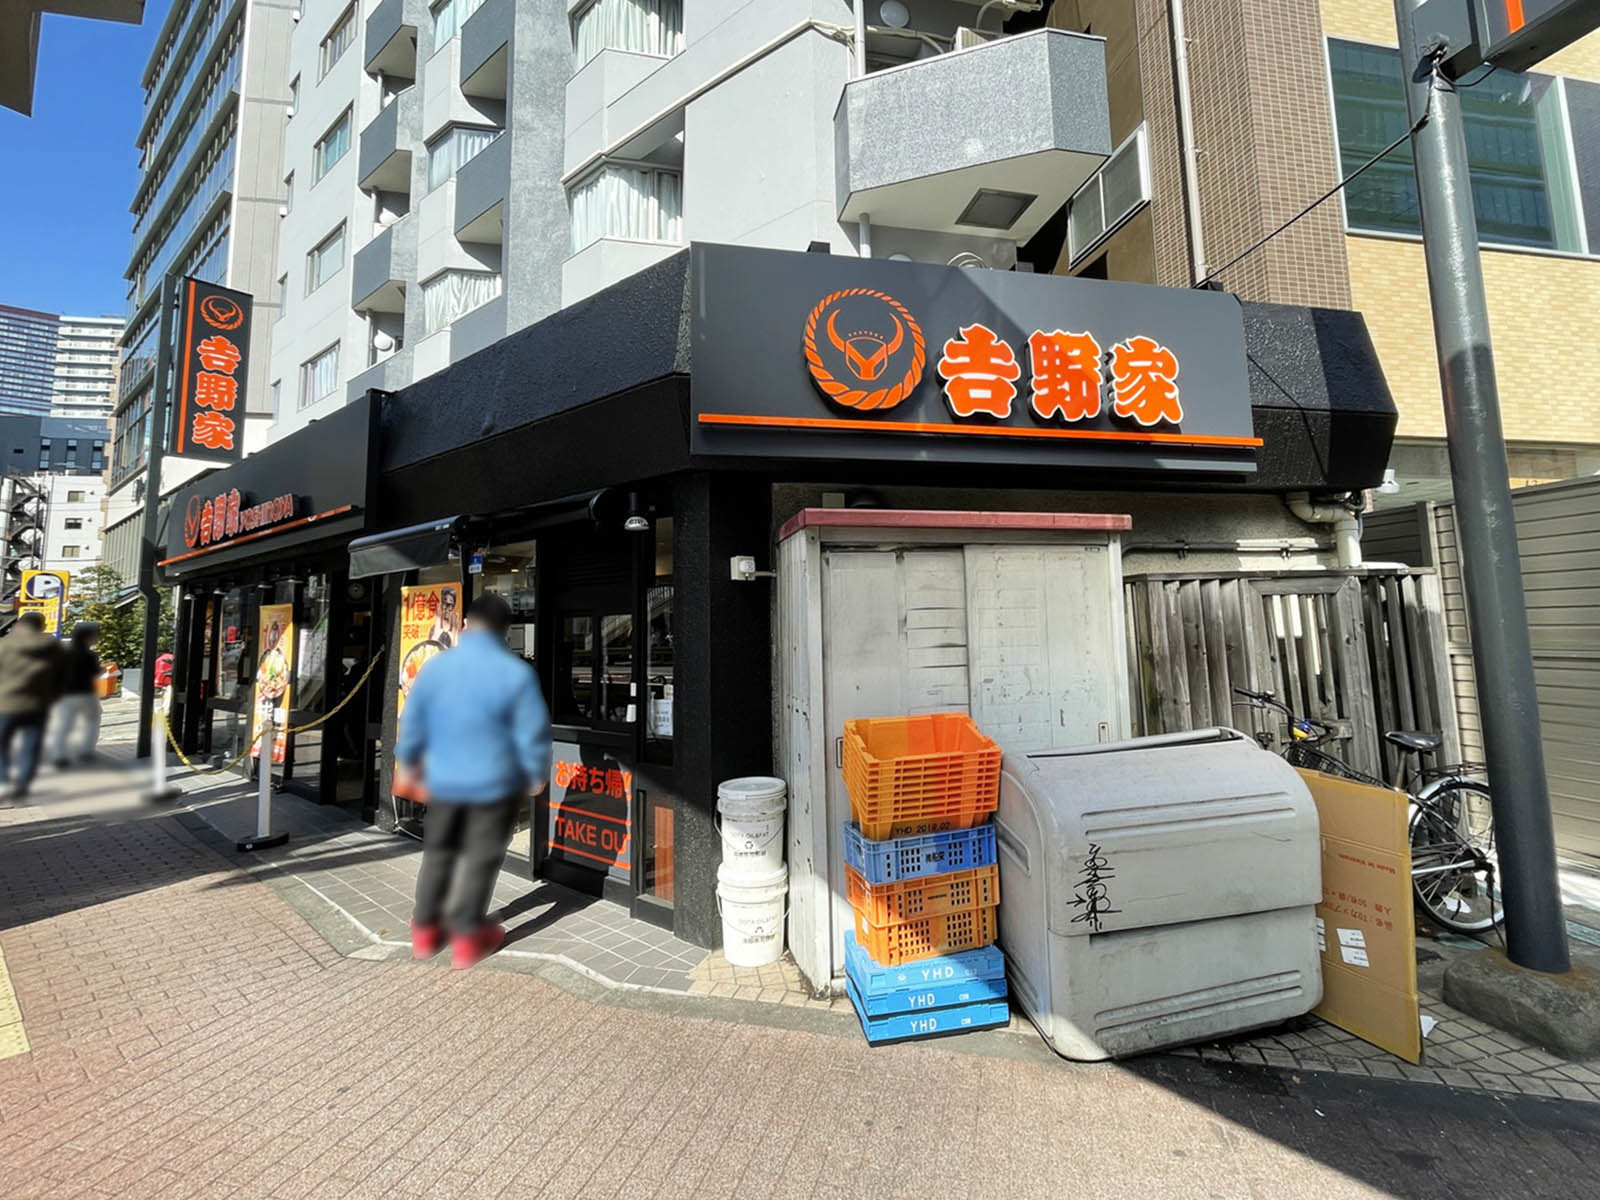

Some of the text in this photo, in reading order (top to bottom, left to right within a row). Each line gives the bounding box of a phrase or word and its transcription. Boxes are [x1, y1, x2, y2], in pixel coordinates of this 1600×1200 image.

[936, 322, 1184, 427] 吉野家
[192, 335, 242, 450] 吉野家
[555, 814, 632, 854] TAKE OU
[921, 966, 954, 981] YHD
[908, 993, 935, 1009] YHD
[910, 1018, 937, 1033] YHD
